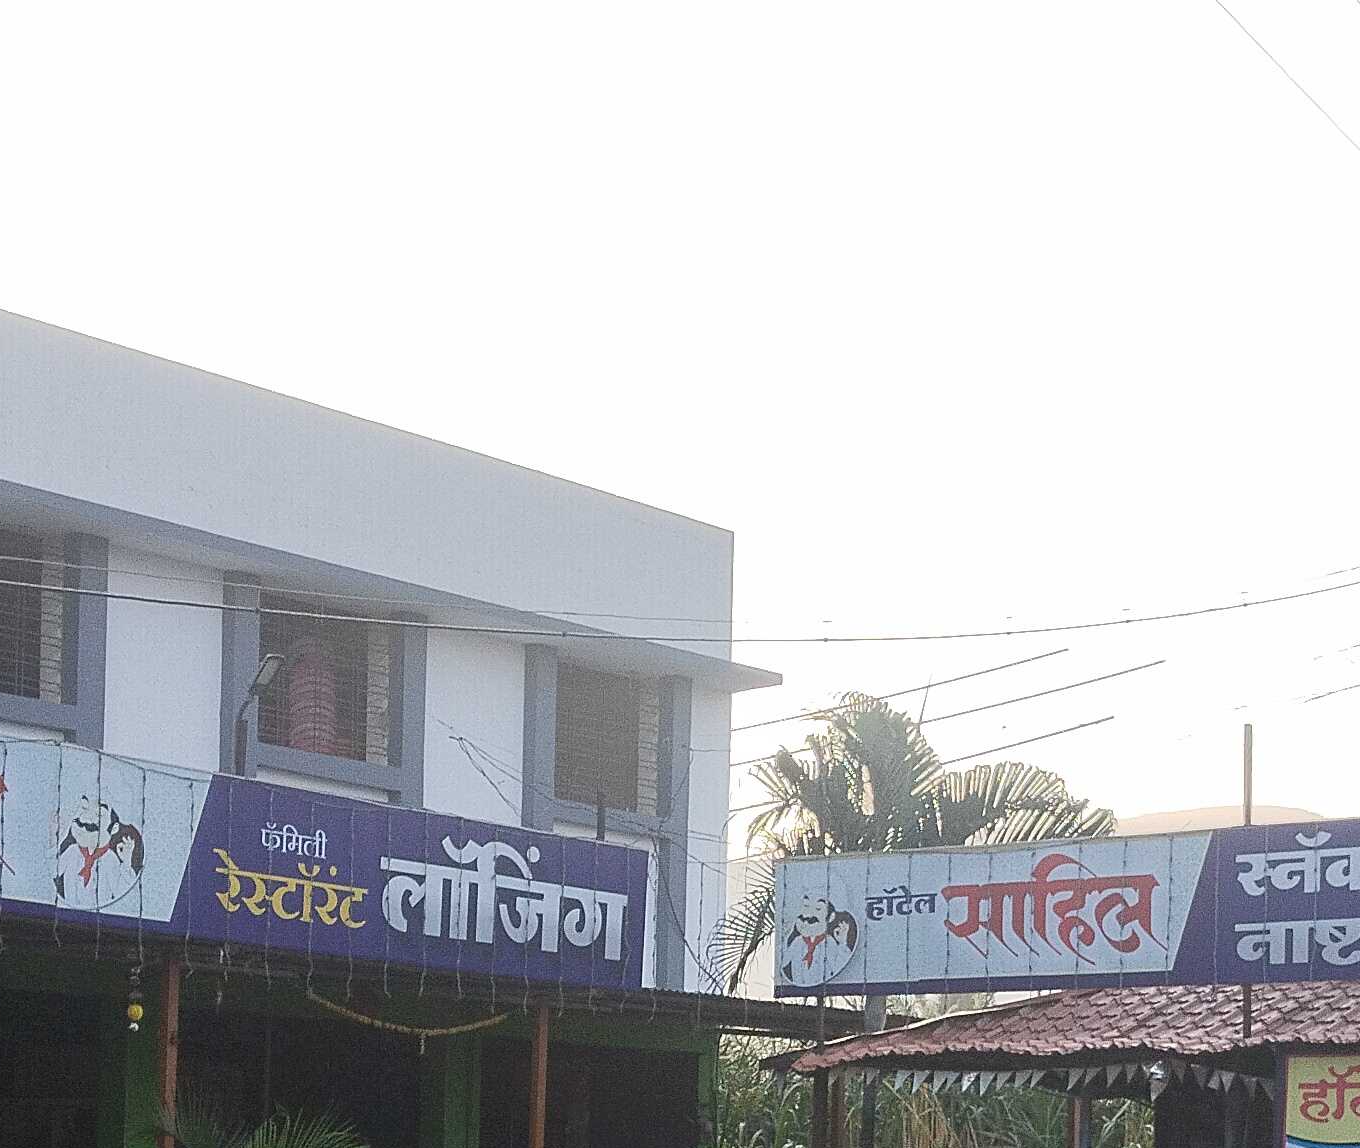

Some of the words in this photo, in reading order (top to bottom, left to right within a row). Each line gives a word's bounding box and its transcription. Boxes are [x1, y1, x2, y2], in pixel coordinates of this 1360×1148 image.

[212, 848, 369, 929] रेस्टॉरंट
[261, 822, 328, 860] फॅमिली
[380, 835, 630, 961] लॉजिंग
[865, 885, 937, 921] हॉटेल
[941, 853, 1168, 965] साहिल
